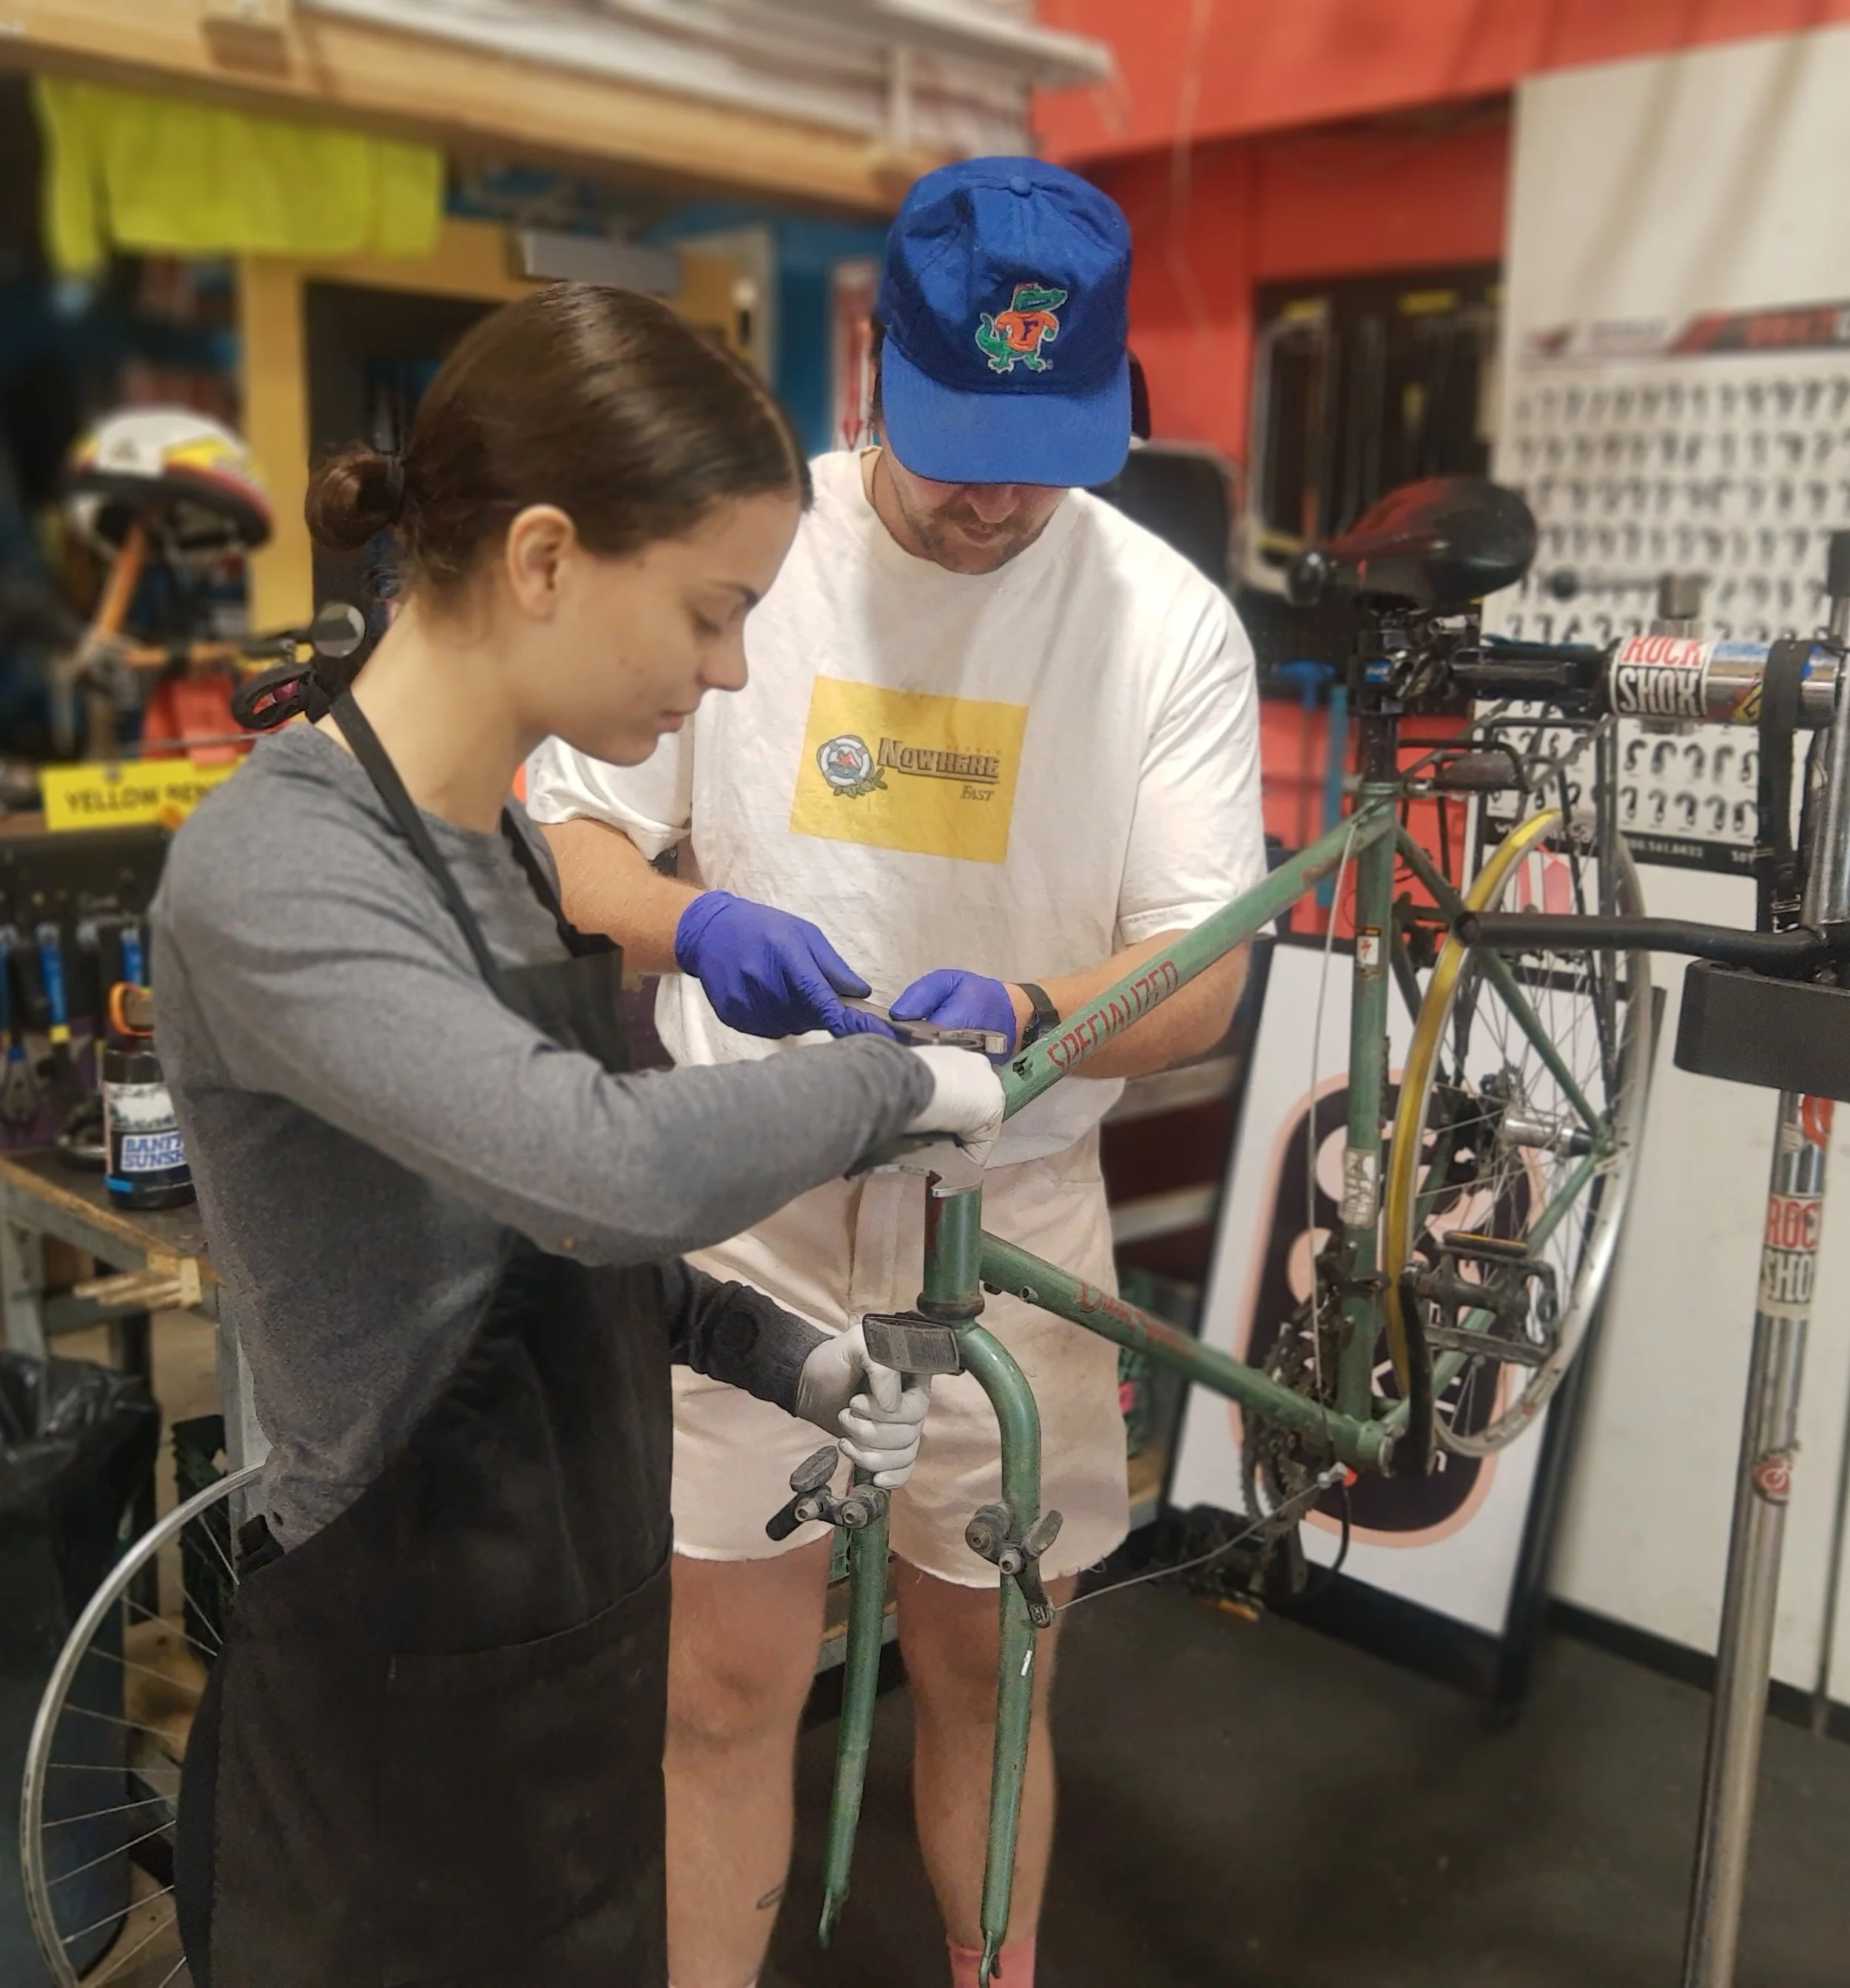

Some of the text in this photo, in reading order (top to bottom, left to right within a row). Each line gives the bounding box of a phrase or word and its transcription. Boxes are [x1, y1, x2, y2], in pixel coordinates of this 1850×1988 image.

[1020, 319, 1038, 341] F
[1618, 667, 1701, 717] SHOX
[63, 784, 159, 815] YELLOW
[959, 785, 995, 802] FAST
[1046, 960, 1179, 1069] SPECIALIZED
[1765, 1196, 1823, 1249] ROC
[1762, 1249, 1815, 1302] SHO
